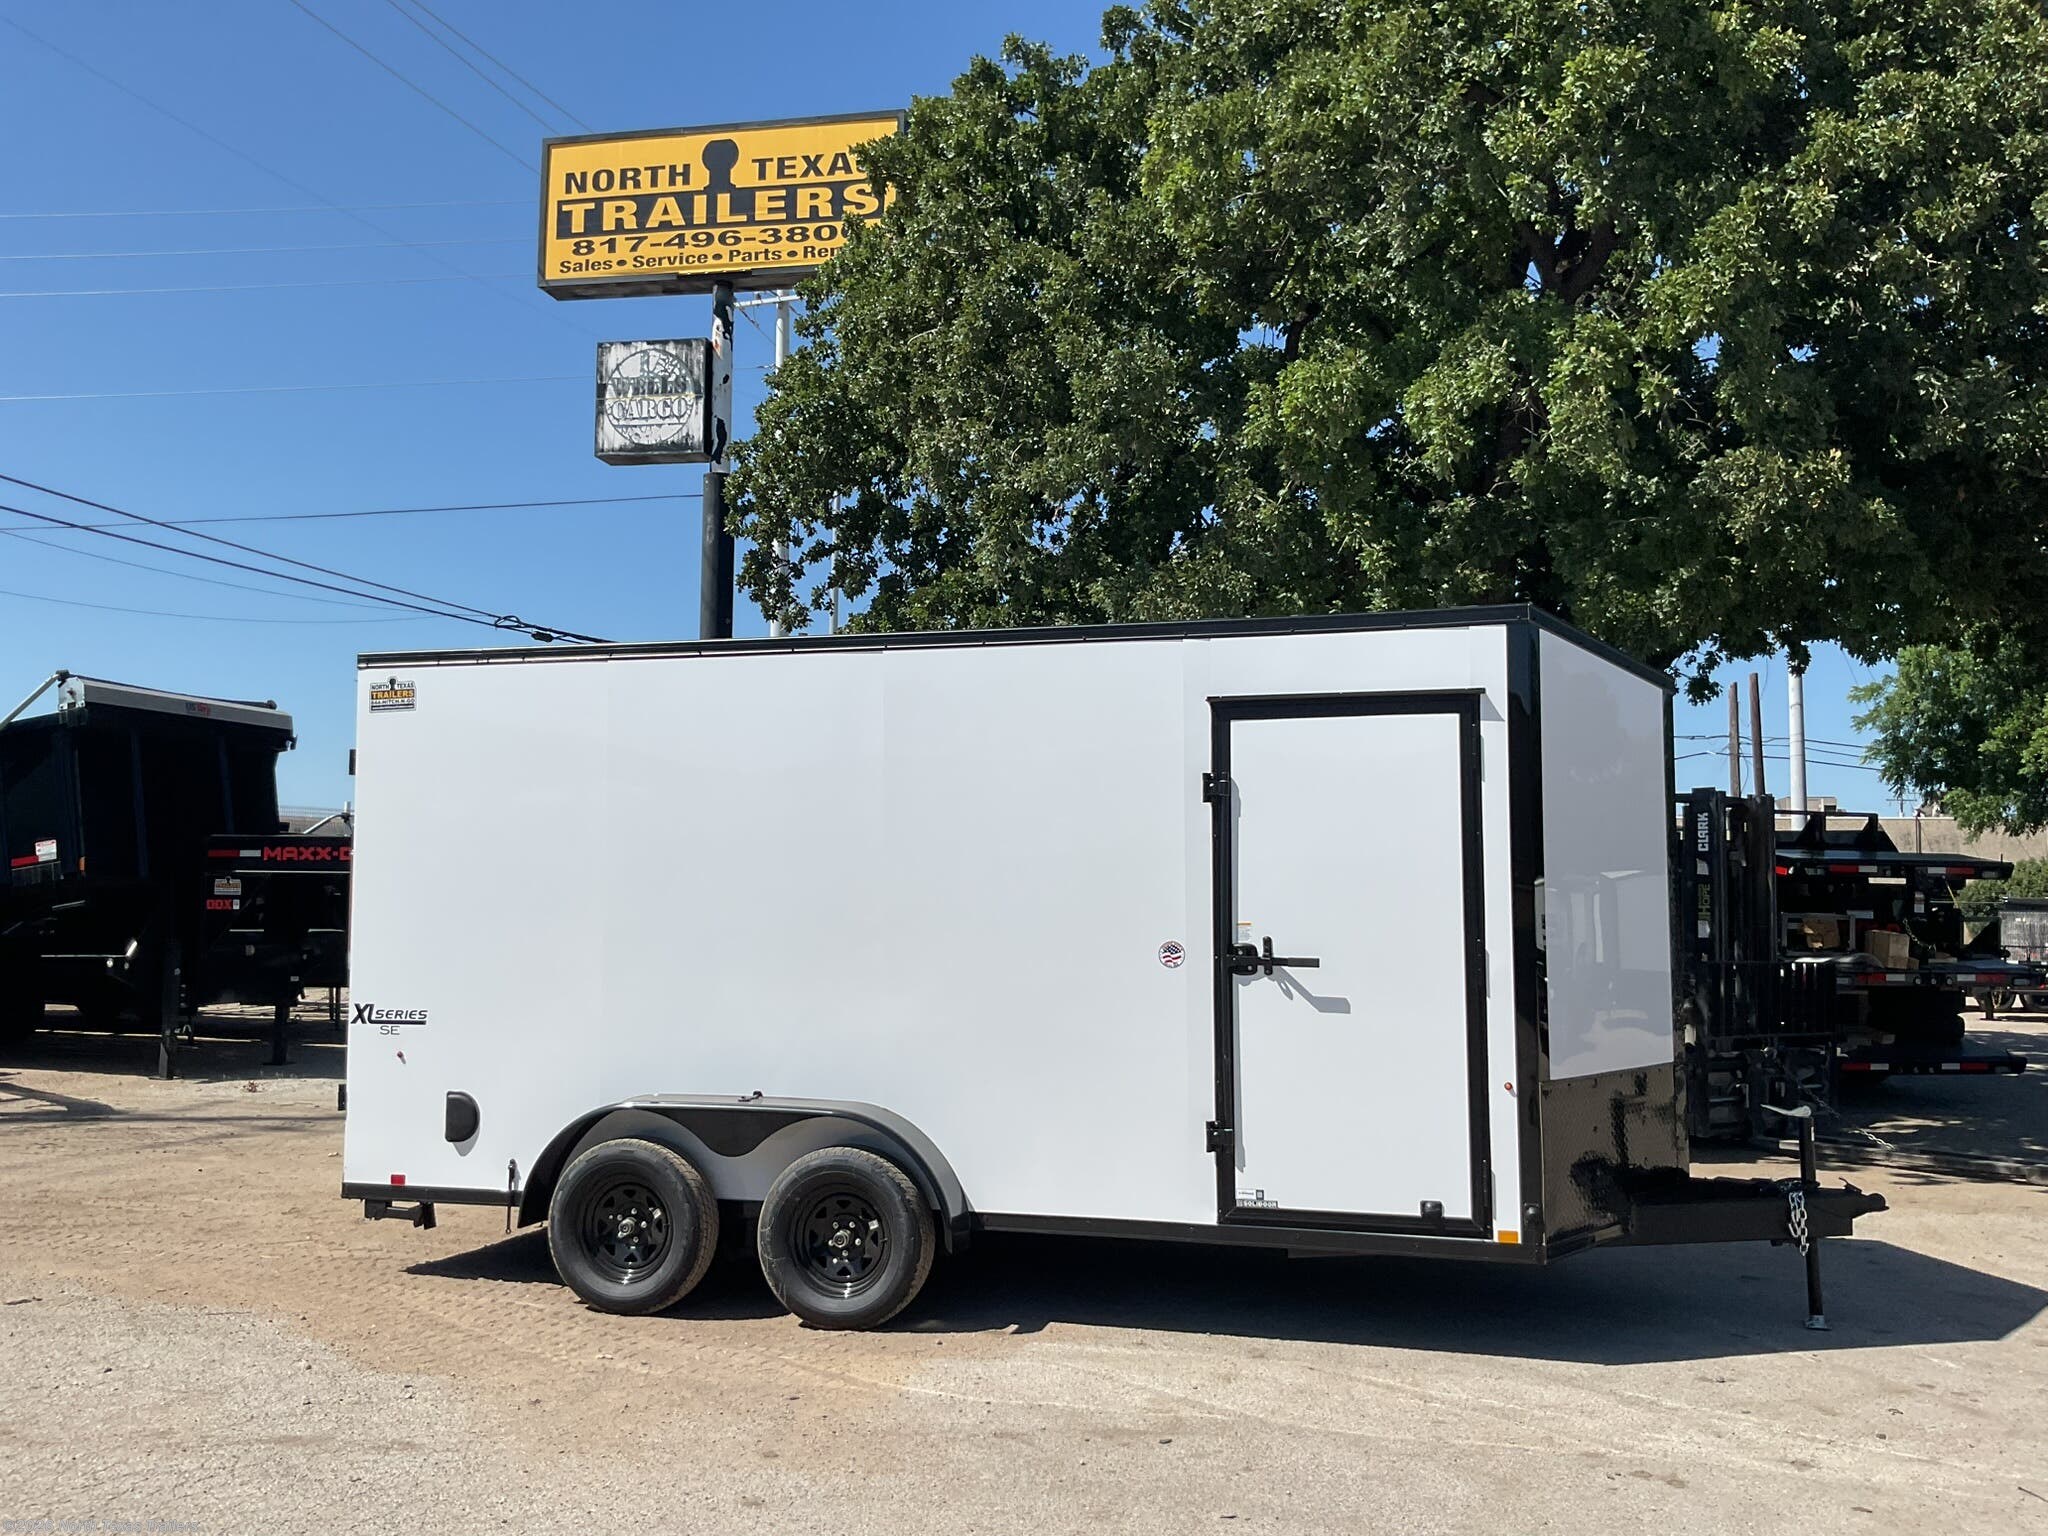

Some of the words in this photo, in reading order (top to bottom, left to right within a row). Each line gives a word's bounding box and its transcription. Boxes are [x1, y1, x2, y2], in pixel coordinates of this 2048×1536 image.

[565, 163, 691, 195] NORTH
[562, 183, 879, 234] TRAILERS
[572, 225, 848, 257] 817-496-380
[559, 258, 613, 274] Sales
[632, 252, 709, 268] Service
[728, 248, 782, 263] Parts
[611, 397, 688, 420] CARGO
[371, 690, 414, 699] TRAILERS
[1697, 812, 1709, 852] CLARK
[375, 1009, 428, 1020] SERIES
[379, 1025, 401, 1036] SE
